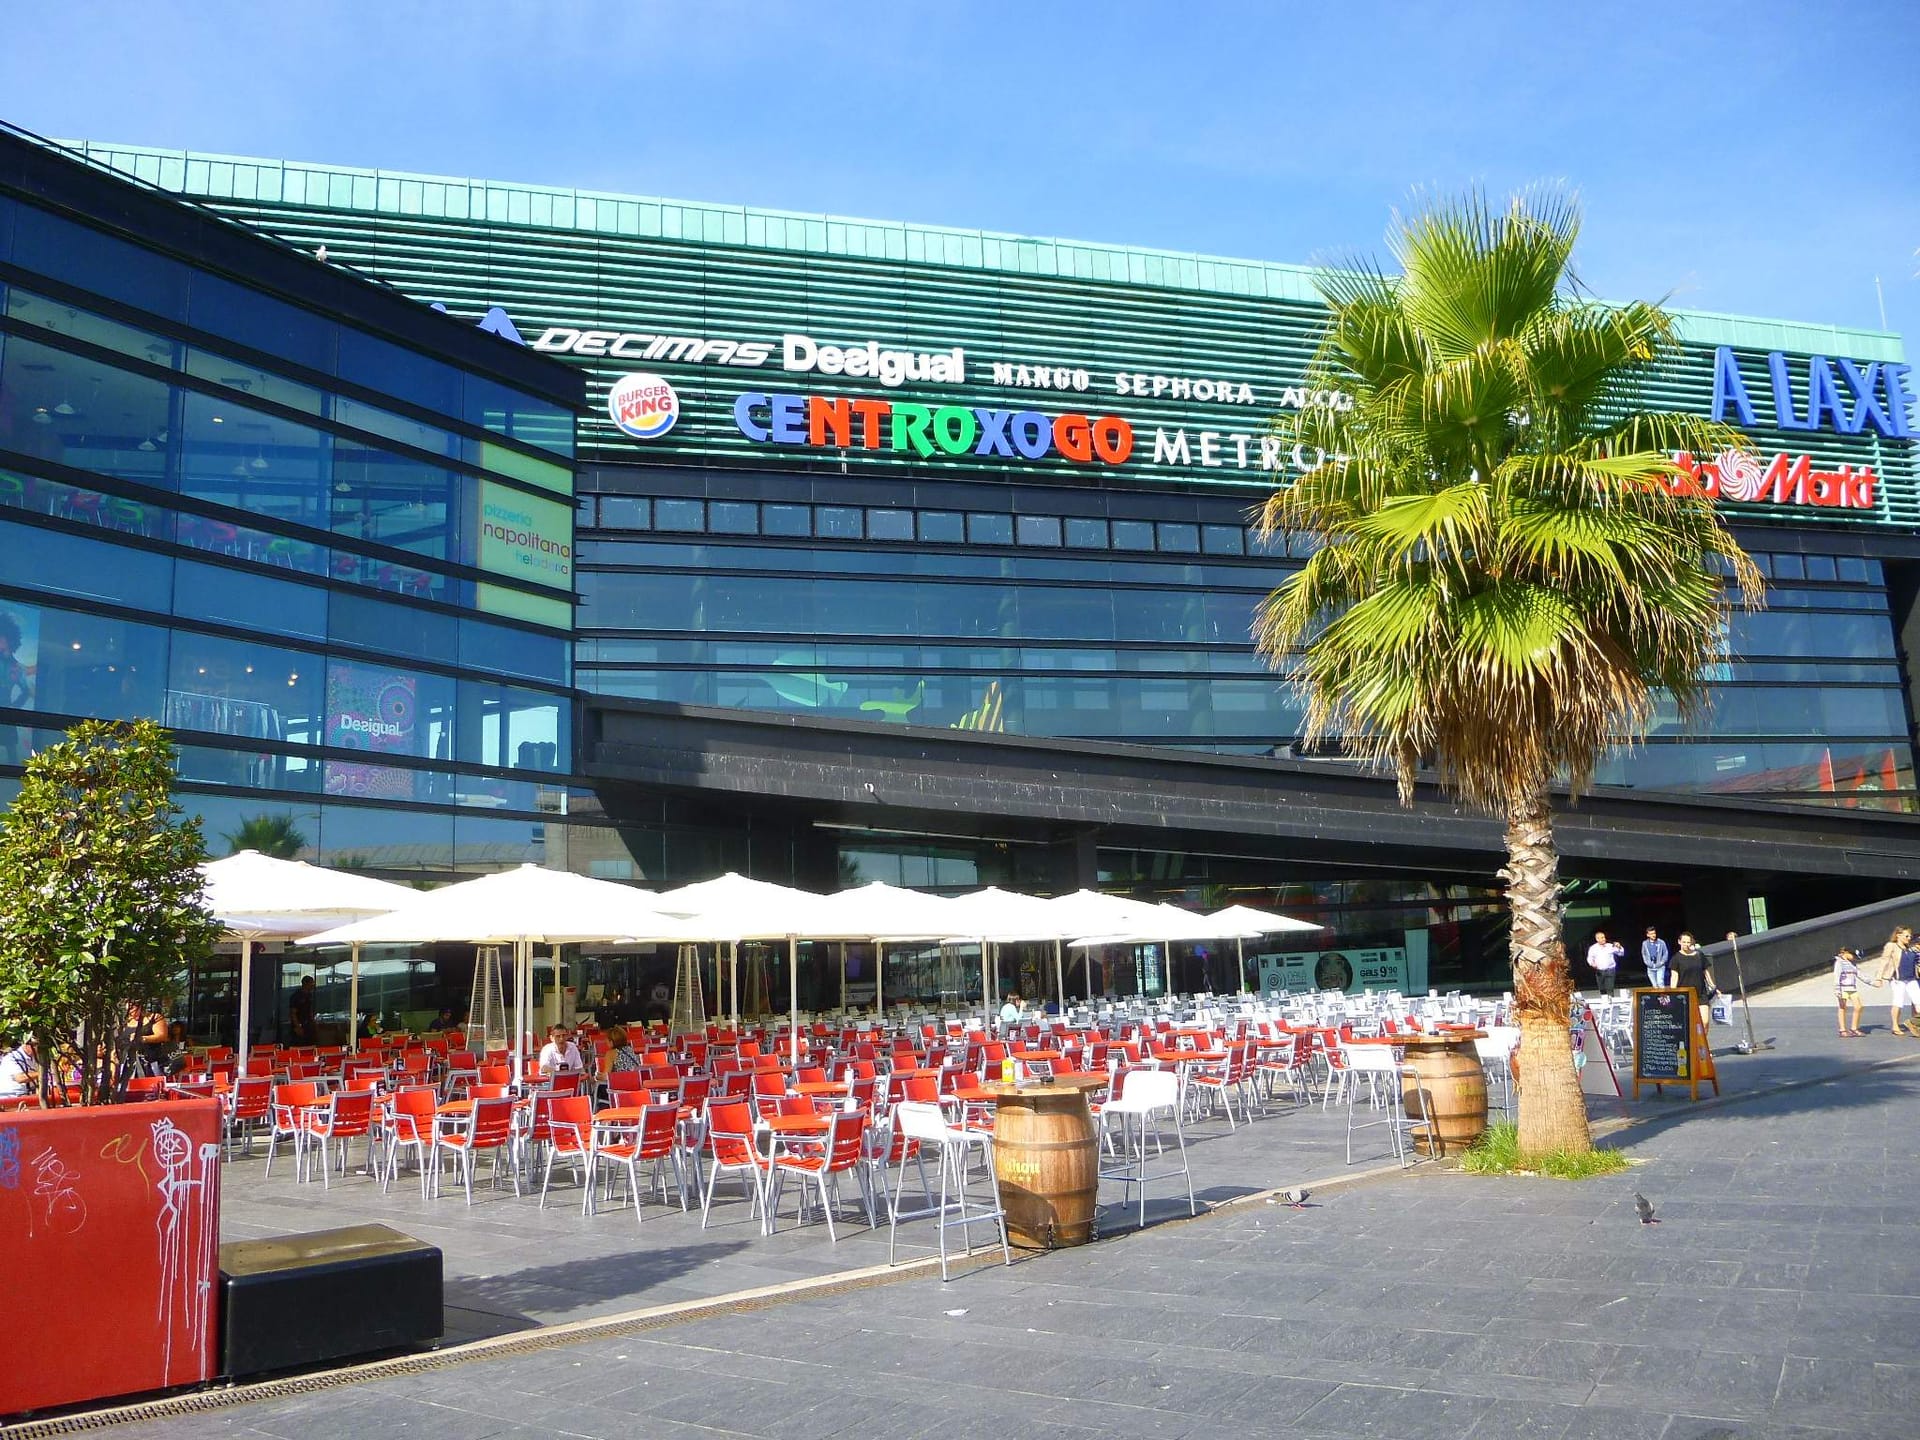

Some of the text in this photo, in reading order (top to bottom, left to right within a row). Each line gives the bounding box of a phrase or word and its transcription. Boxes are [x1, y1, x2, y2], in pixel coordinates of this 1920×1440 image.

[532, 326, 776, 366] DECIMAS
[782, 333, 967, 387] Desigual
[992, 361, 1091, 393] MANGO
[1115, 371, 1256, 405] SEPHORA
[618, 385, 670, 407] BURGER
[620, 396, 673, 424] KING
[1756, 452, 1879, 509] Markt
[484, 503, 533, 527] pizzeria
[483, 521, 571, 558] napolitana
